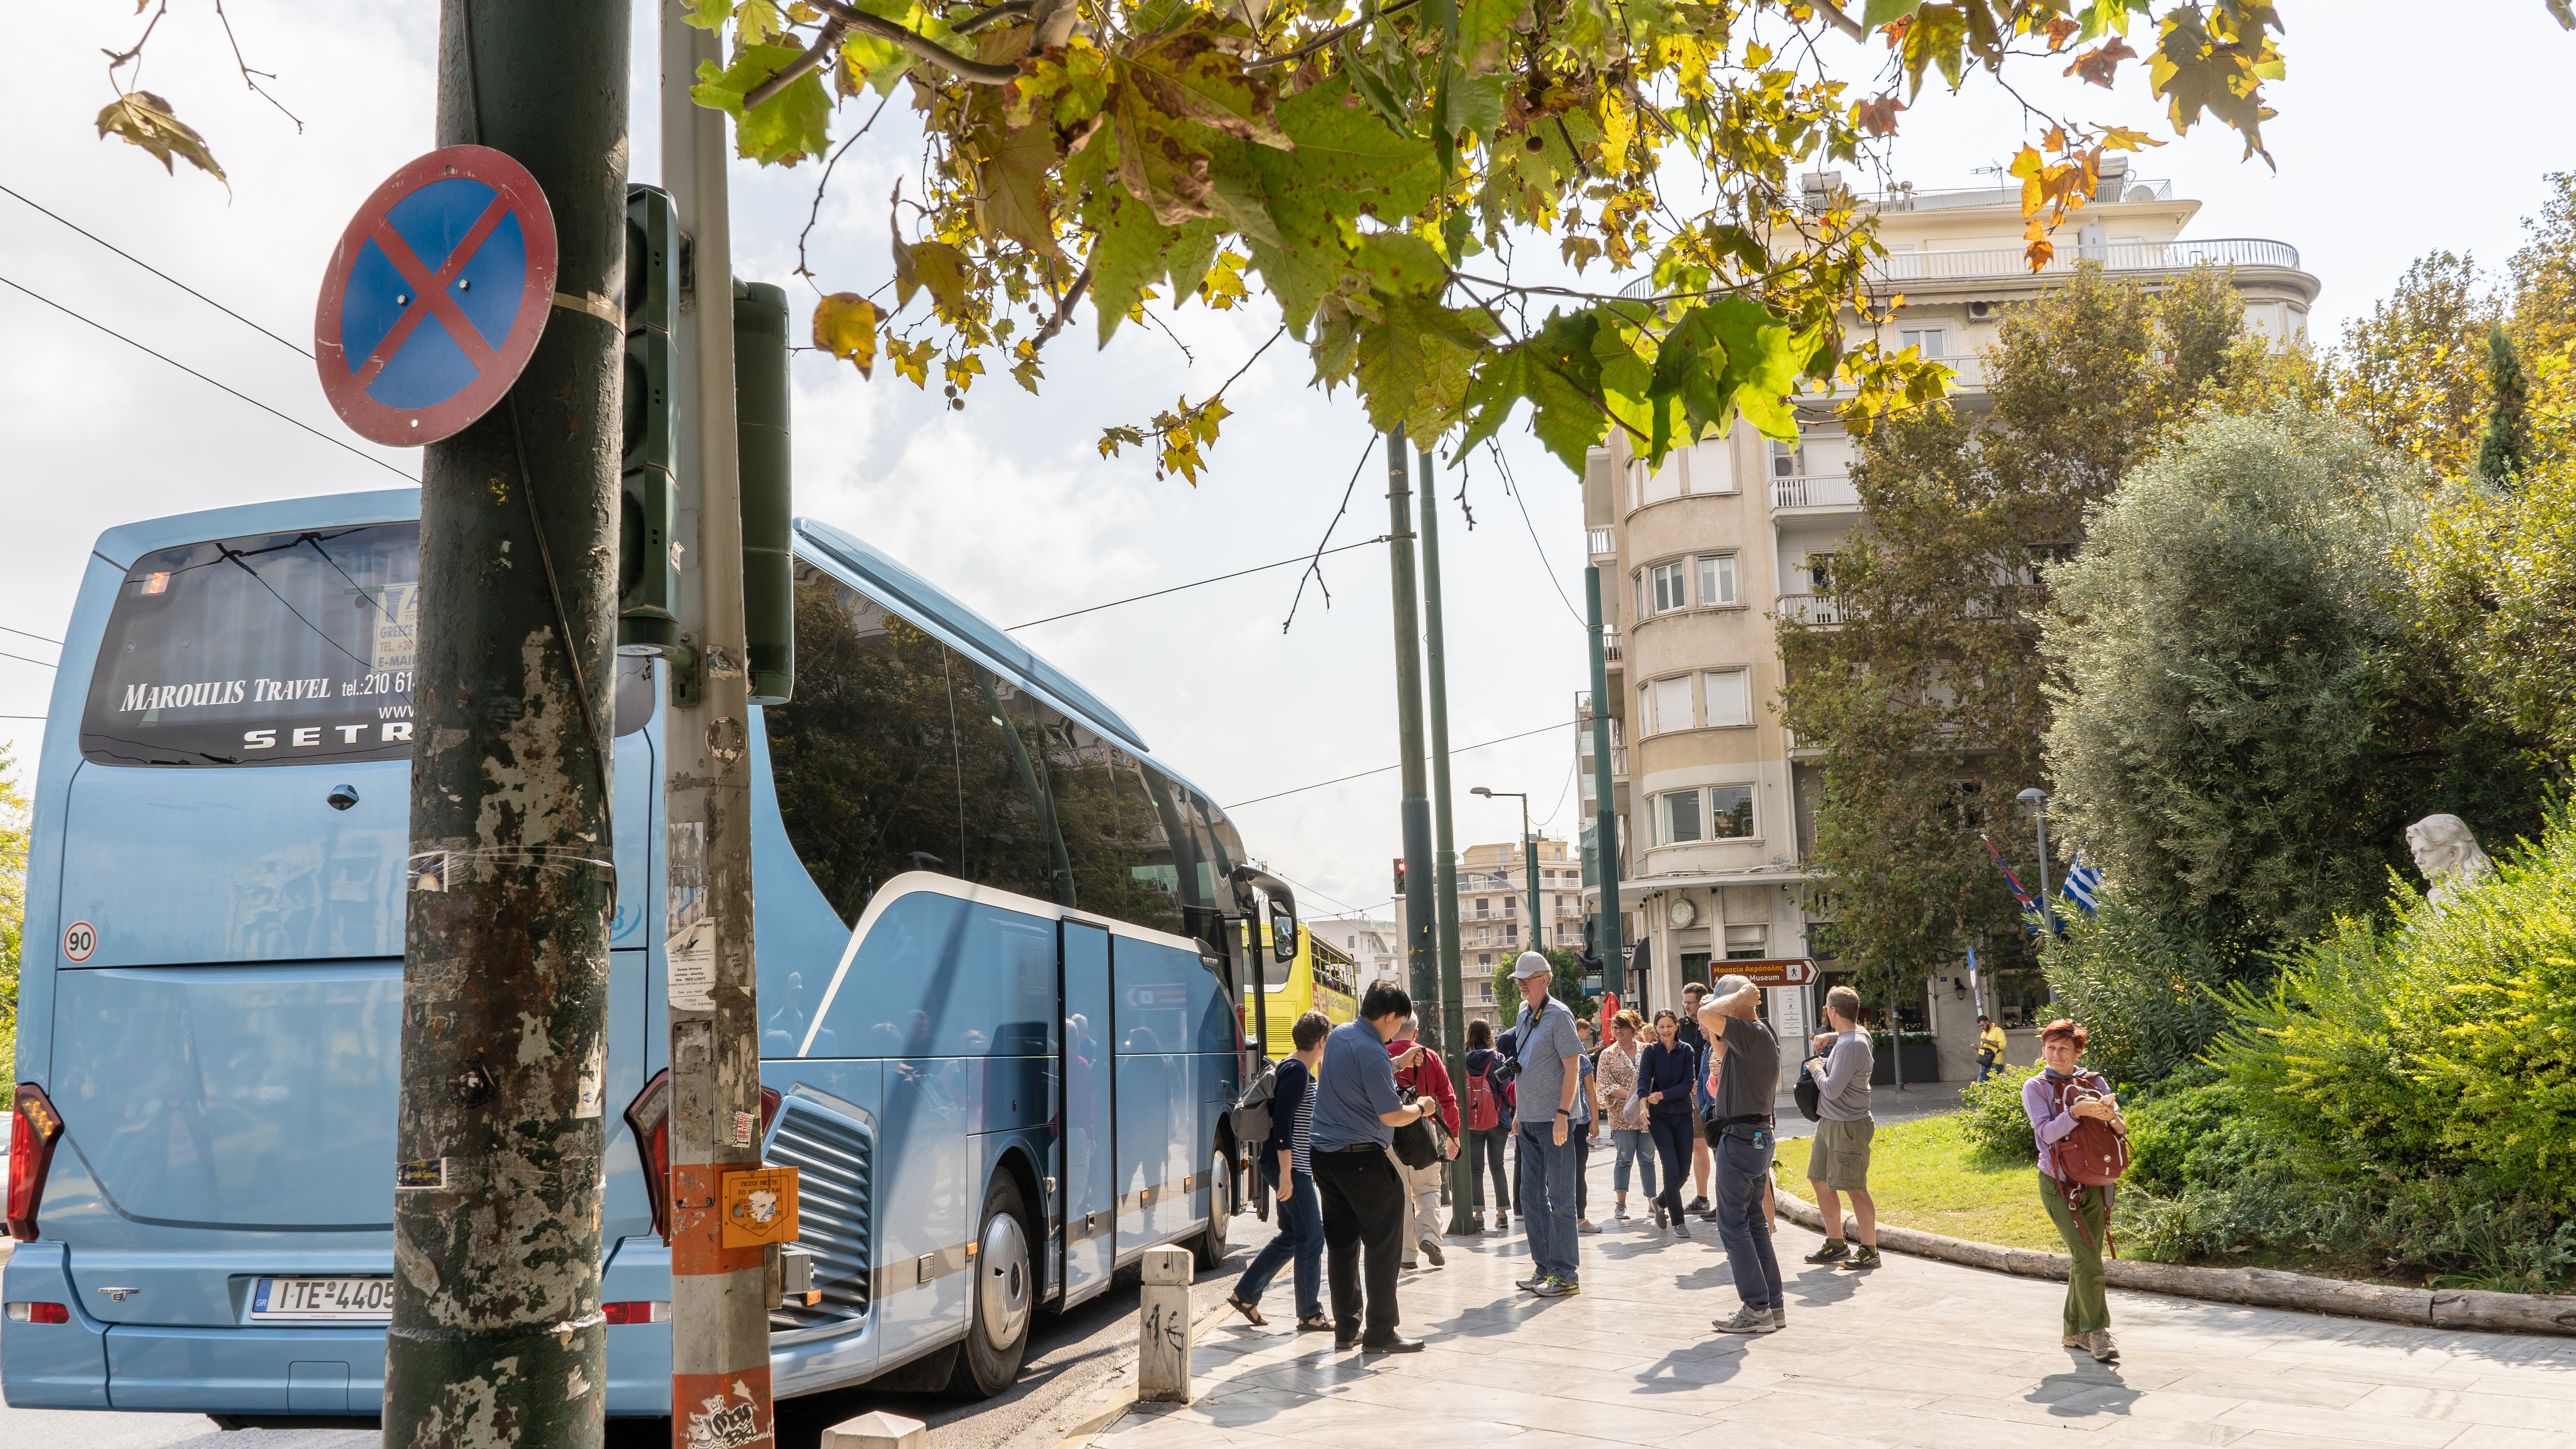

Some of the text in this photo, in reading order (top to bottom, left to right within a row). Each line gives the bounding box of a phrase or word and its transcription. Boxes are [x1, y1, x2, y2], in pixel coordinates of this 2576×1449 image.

[380, 624, 413, 638] GREECE
[380, 640, 413, 653] TEL. +30
[119, 679, 246, 712] MAROULIS
[253, 677, 332, 703] TRAVEL
[395, 671, 416, 693] 61
[243, 722, 413, 750] SETR
[68, 931, 91, 952] 90
[1744, 964, 1784, 973] Ακρόπολης
[256, 1299, 267, 1307] GR
